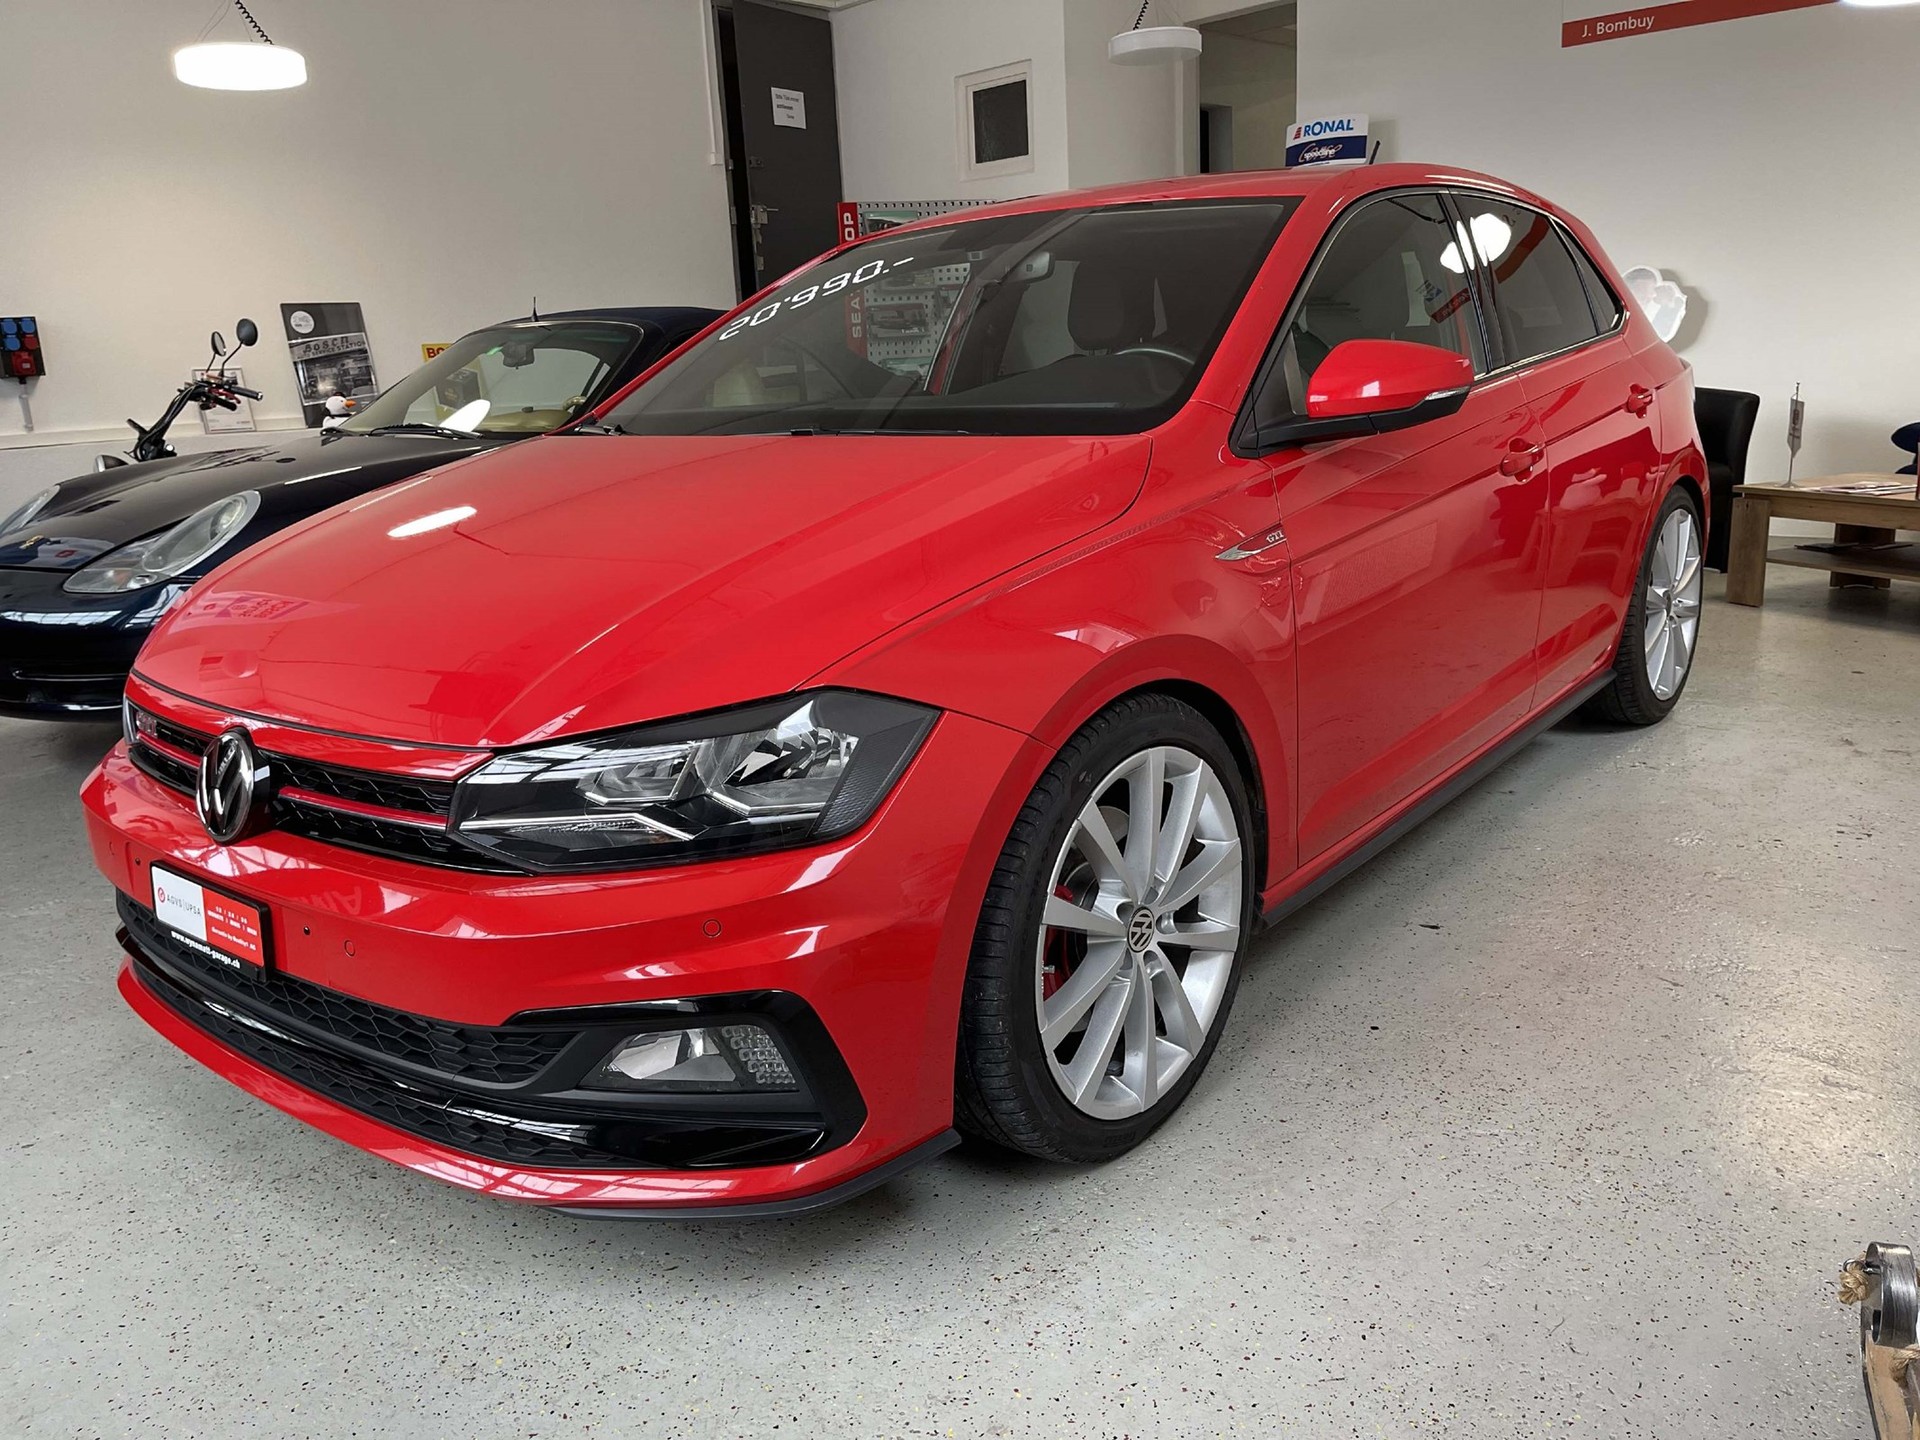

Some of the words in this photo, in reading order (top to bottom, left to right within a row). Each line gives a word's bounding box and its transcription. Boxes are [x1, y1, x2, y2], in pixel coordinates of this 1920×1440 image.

[1582, 24, 1591, 37] J.
[1596, 16, 1655, 35] Bombuy
[1303, 119, 1354, 137] RONAL
[850, 289, 863, 338] SEA
[1266, 530, 1284, 543] GTI
